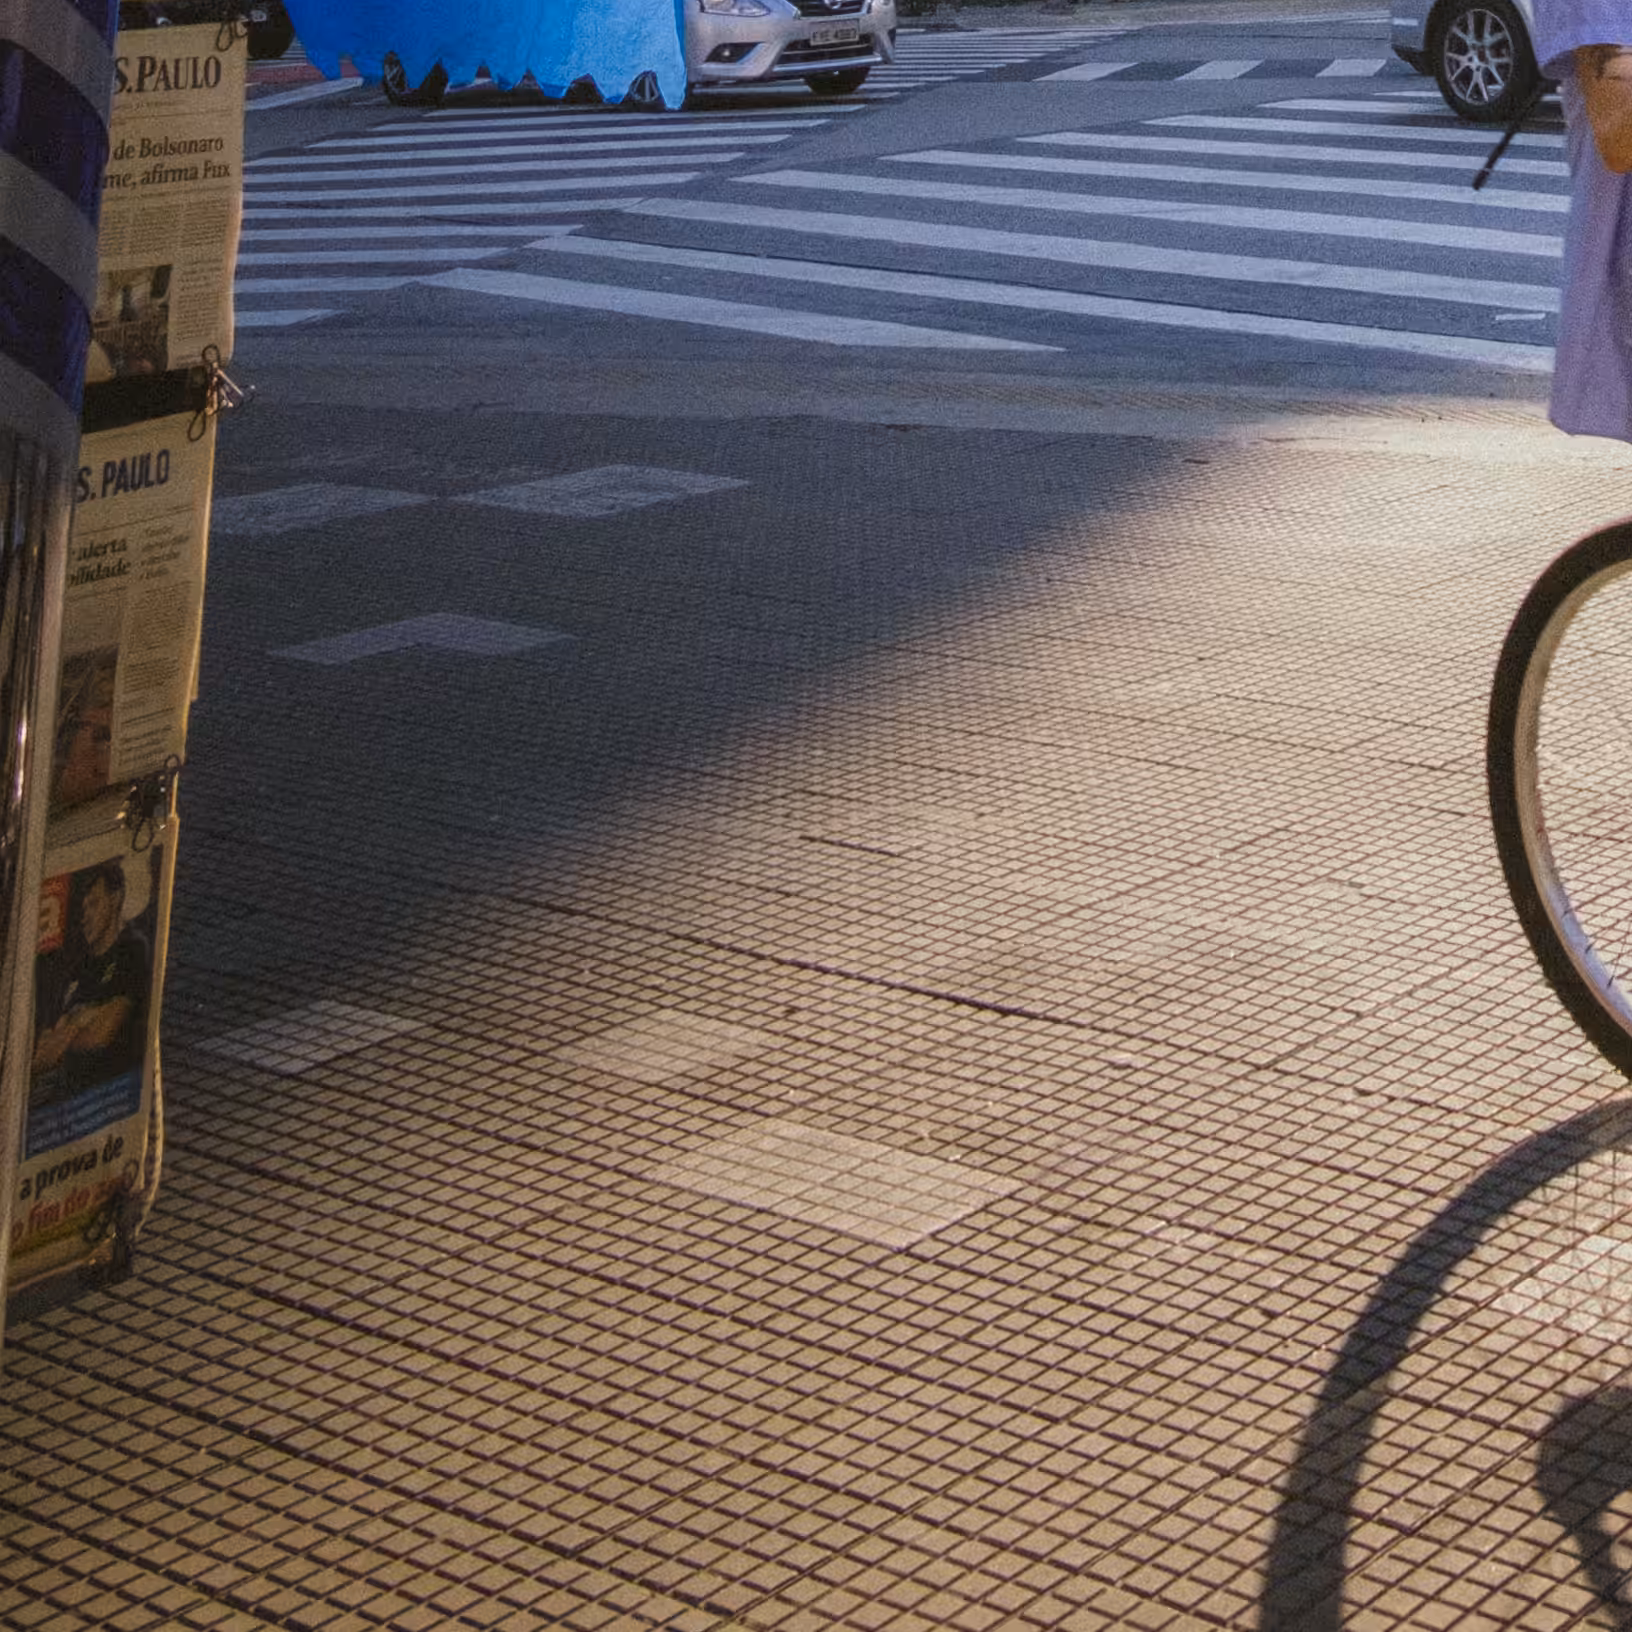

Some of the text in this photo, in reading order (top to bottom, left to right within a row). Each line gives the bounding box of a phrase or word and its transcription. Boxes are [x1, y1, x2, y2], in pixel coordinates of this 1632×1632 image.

[113, 136, 225, 161] de Bolsonaro
[140, 162, 199, 186] afirma
[203, 159, 231, 180] Fux
[102, 448, 171, 498] PAULO
[35, 1148, 98, 1201] prova
